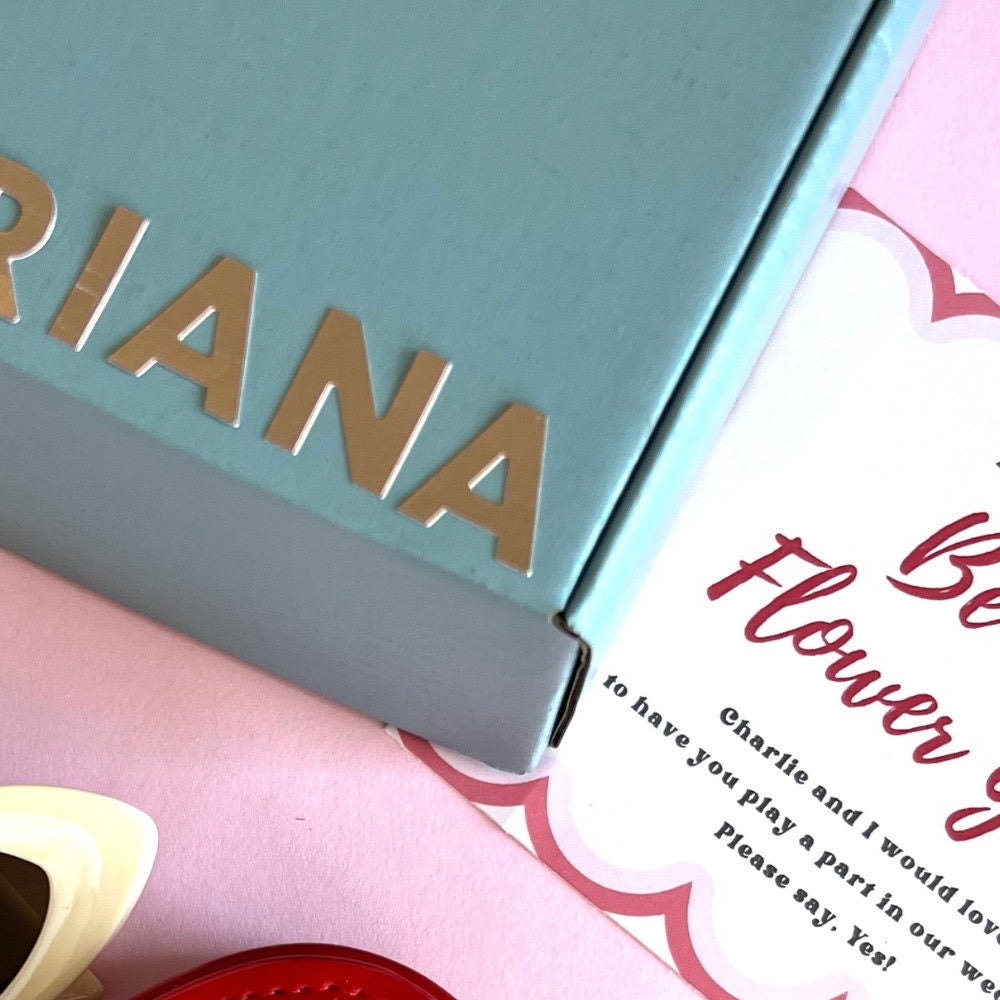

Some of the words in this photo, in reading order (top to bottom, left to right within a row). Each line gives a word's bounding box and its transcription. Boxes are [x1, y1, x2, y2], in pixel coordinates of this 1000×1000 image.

[706, 533, 970, 764] Flower
[602, 675, 628, 698] to
[630, 695, 690, 749] have
[686, 747, 740, 790] you
[736, 788, 797, 836] play
[799, 834, 815, 852] a
[814, 850, 876, 898] part
[875, 892, 903, 923] in
[909, 922, 956, 959] our
[713, 821, 790, 889] Please
[792, 888, 837, 932] say,
[846, 925, 897, 972] Yes!
[719, 707, 809, 785] Charlie
[811, 785, 864, 827] and
[861, 820, 880, 840] I
[880, 836, 960, 904] would
[956, 899, 1000, 945] lov
